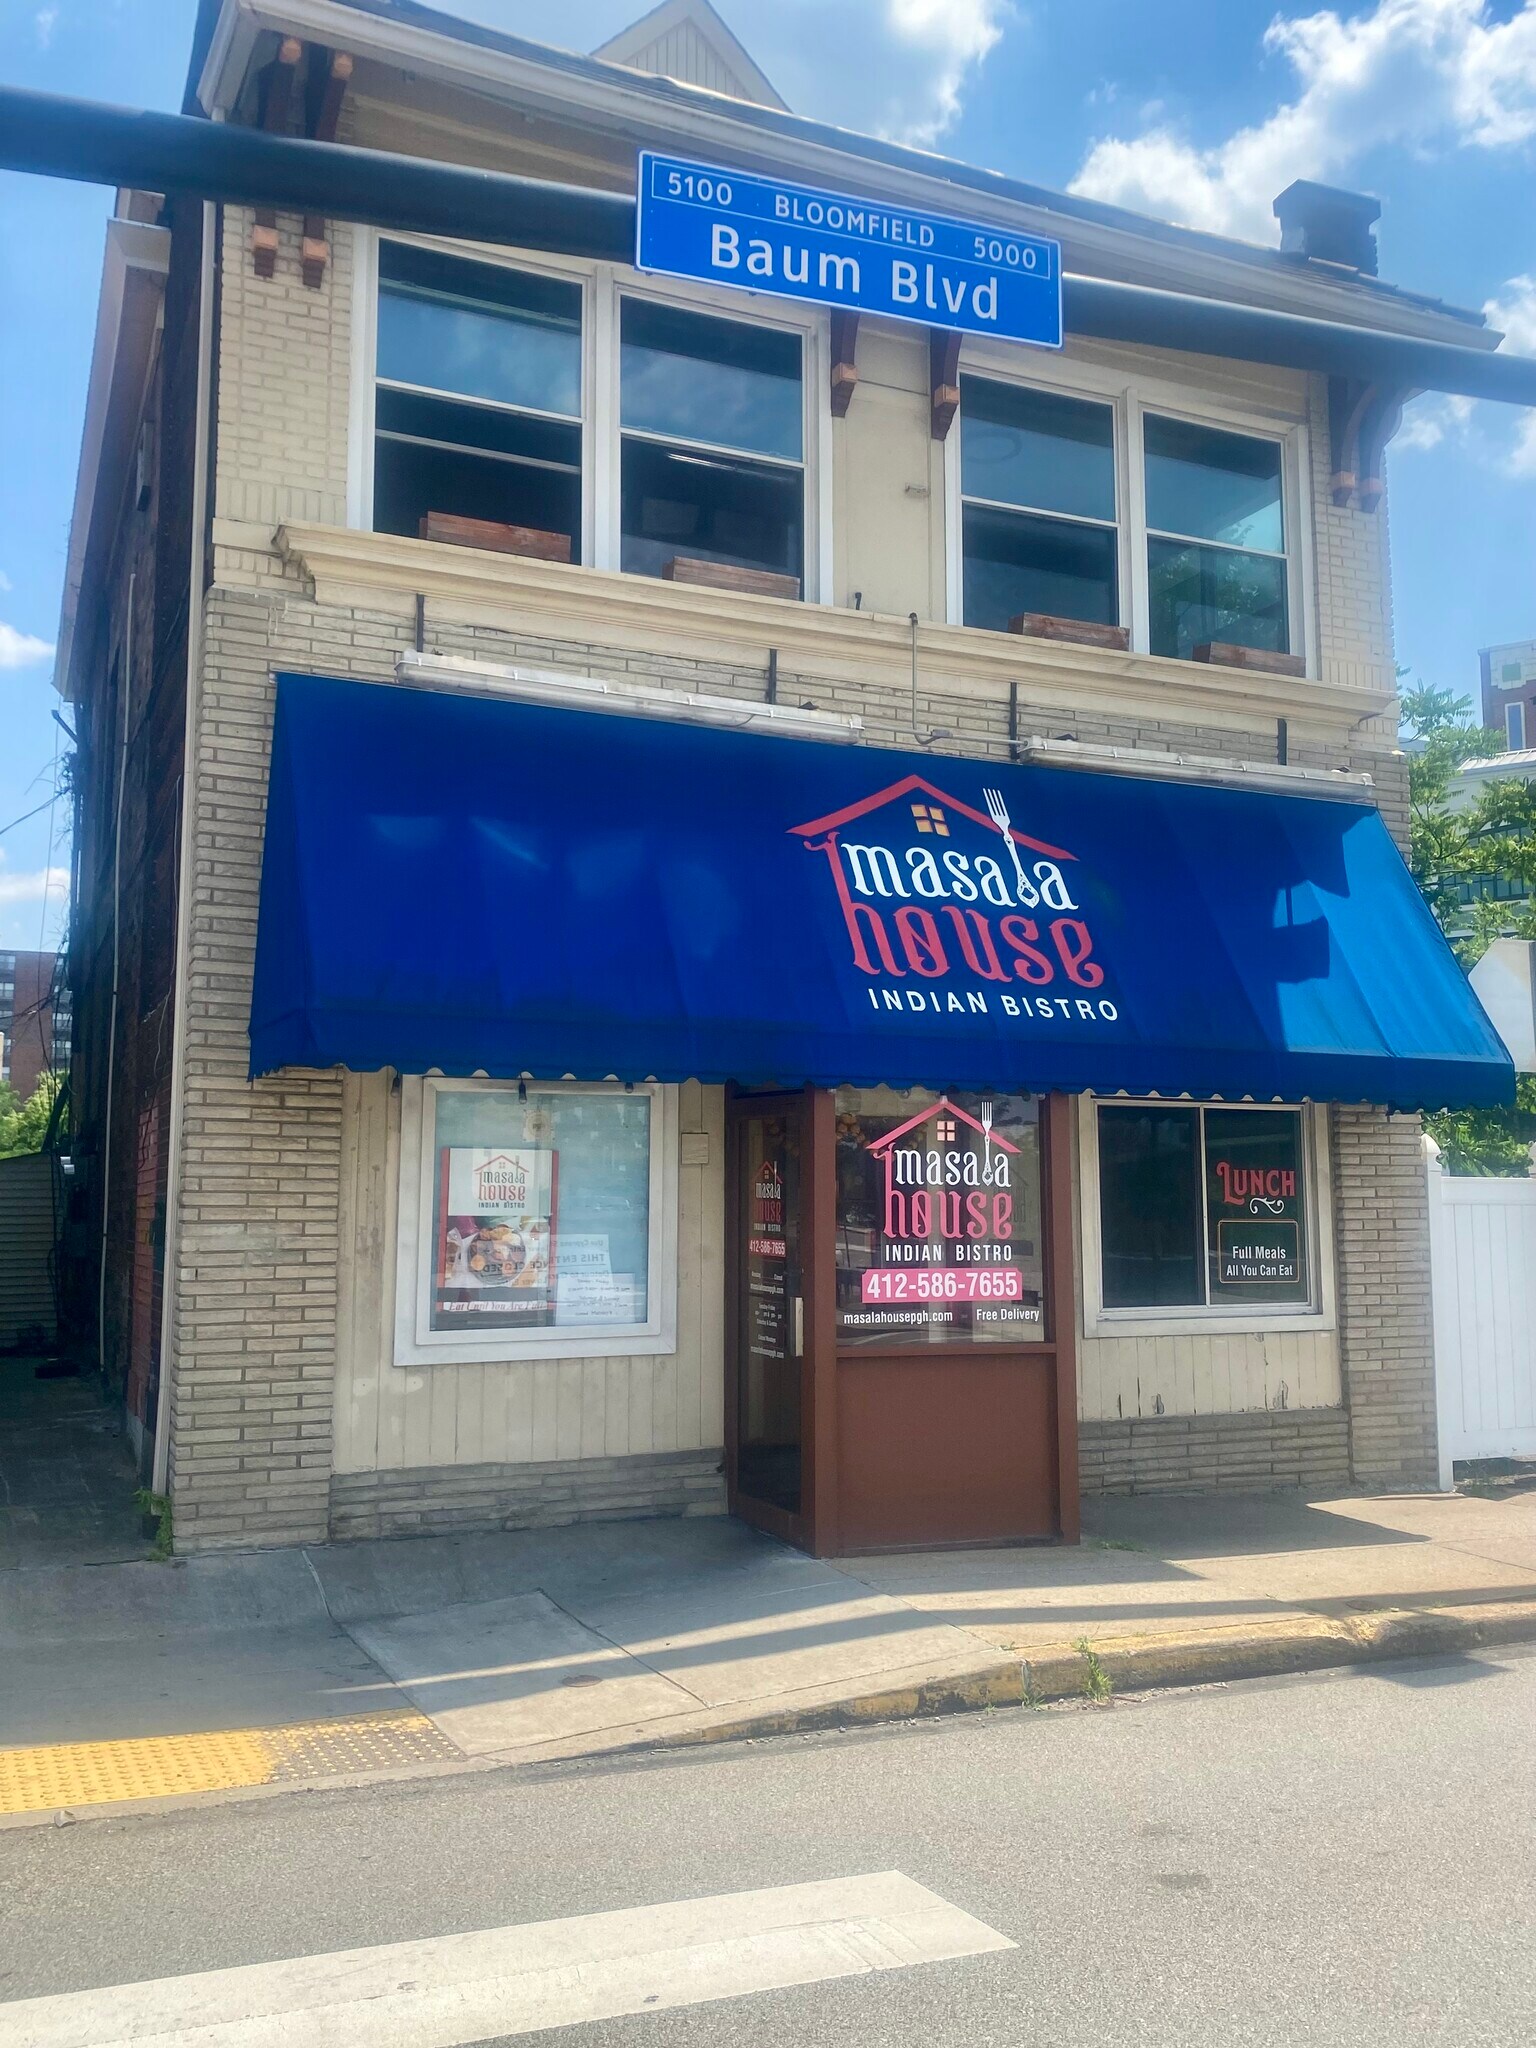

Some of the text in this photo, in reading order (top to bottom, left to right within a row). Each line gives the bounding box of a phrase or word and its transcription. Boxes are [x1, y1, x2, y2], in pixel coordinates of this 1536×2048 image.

[668, 171, 1037, 270] 5100 BLOOMFIELD 5000
[711, 223, 998, 321] Baum Blvd
[841, 833, 1079, 911] masala
[804, 832, 1104, 988] house
[868, 988, 1119, 1022] INDIAN BISTRO
[482, 1169, 525, 1184] masala
[894, 1136, 1012, 1188] masala
[873, 1142, 1013, 1239] house
[1216, 1161, 1296, 1205] LUNCH
[885, 1244, 1012, 1262] INDIAN BISTRO
[1226, 1264, 1293, 1276] All You Can Eat
[1232, 1245, 1286, 1260] Full Meals
[867, 1271, 1018, 1299] 412-586-7655
[843, 1308, 1040, 1325] masalahousepgh.com Free Delivery
